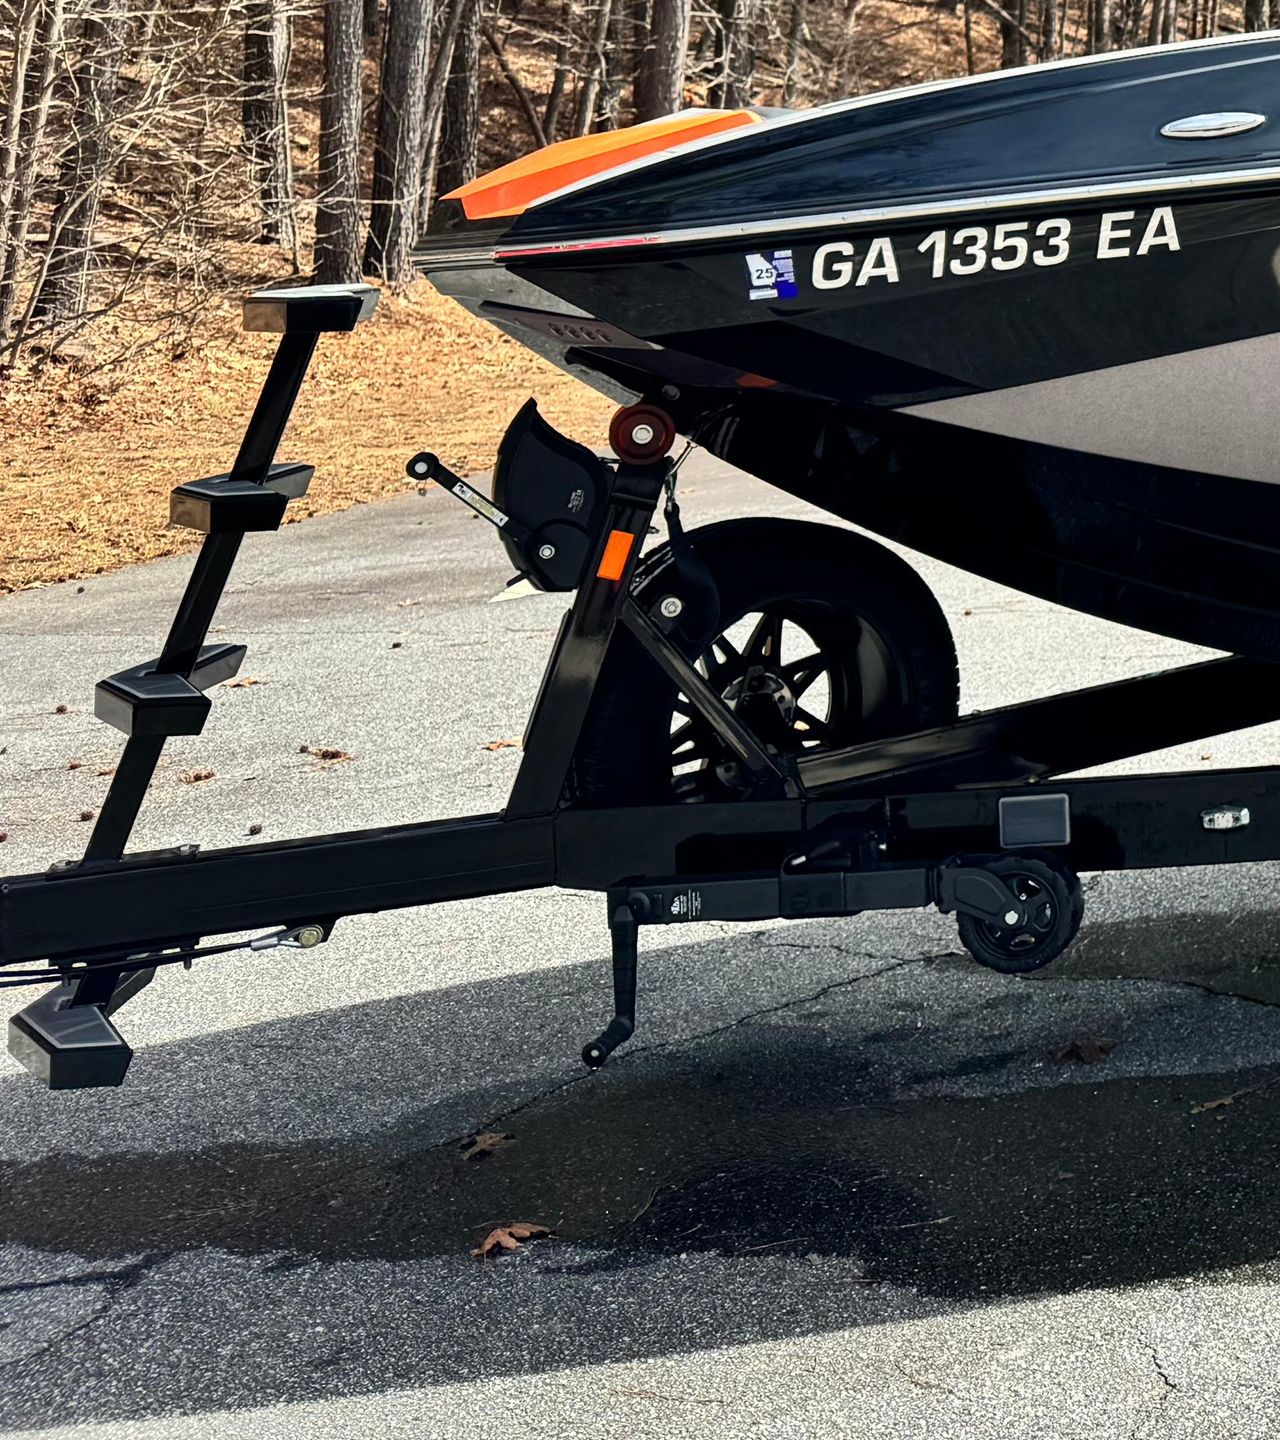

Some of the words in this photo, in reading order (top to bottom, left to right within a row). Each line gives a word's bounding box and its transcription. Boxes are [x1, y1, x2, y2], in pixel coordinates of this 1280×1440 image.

[810, 236, 899, 291] GA
[916, 217, 1072, 280] 1353
[1095, 205, 1182, 261] EA
[755, 268, 773, 280] 25
